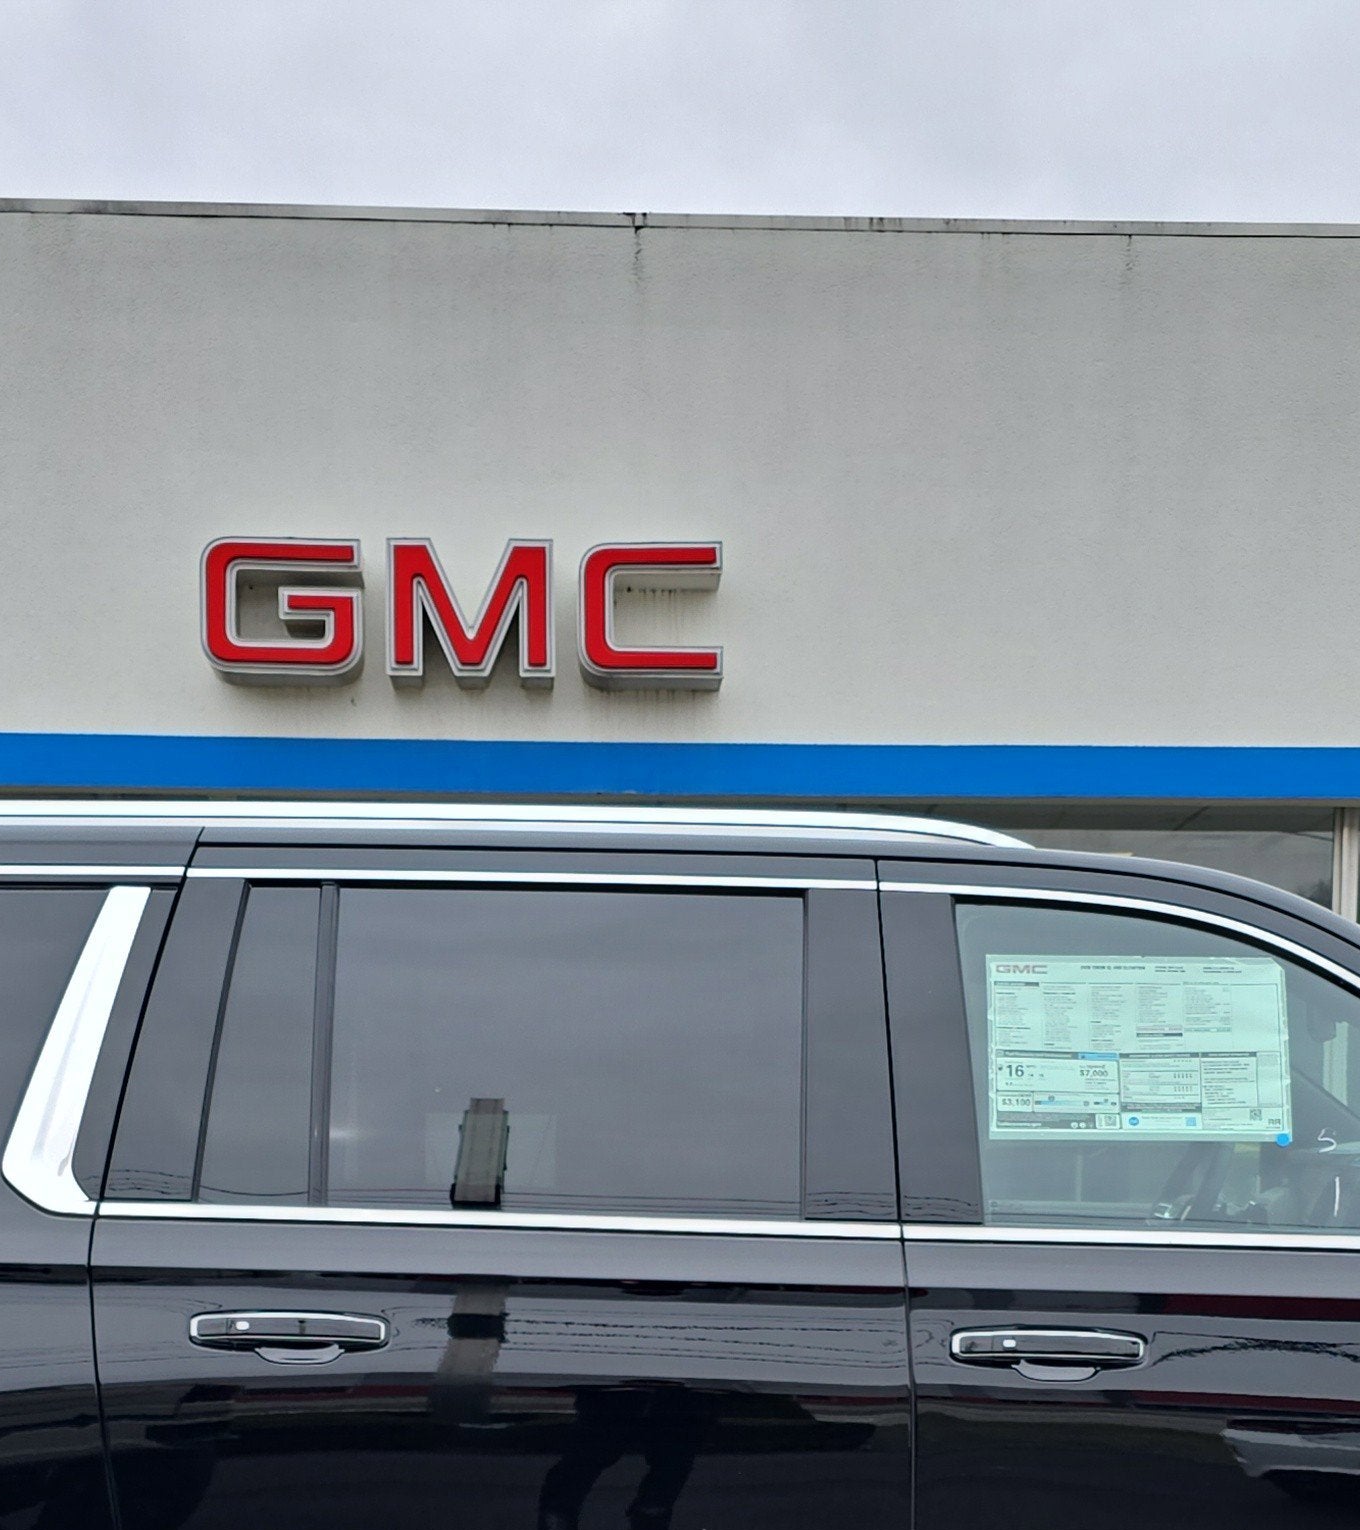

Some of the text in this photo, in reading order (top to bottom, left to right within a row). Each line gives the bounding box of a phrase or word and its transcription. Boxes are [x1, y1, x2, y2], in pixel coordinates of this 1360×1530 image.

[200, 537, 724, 684] GMC
[996, 964, 1048, 975] GMC
[1007, 1064, 1025, 1078] 16
